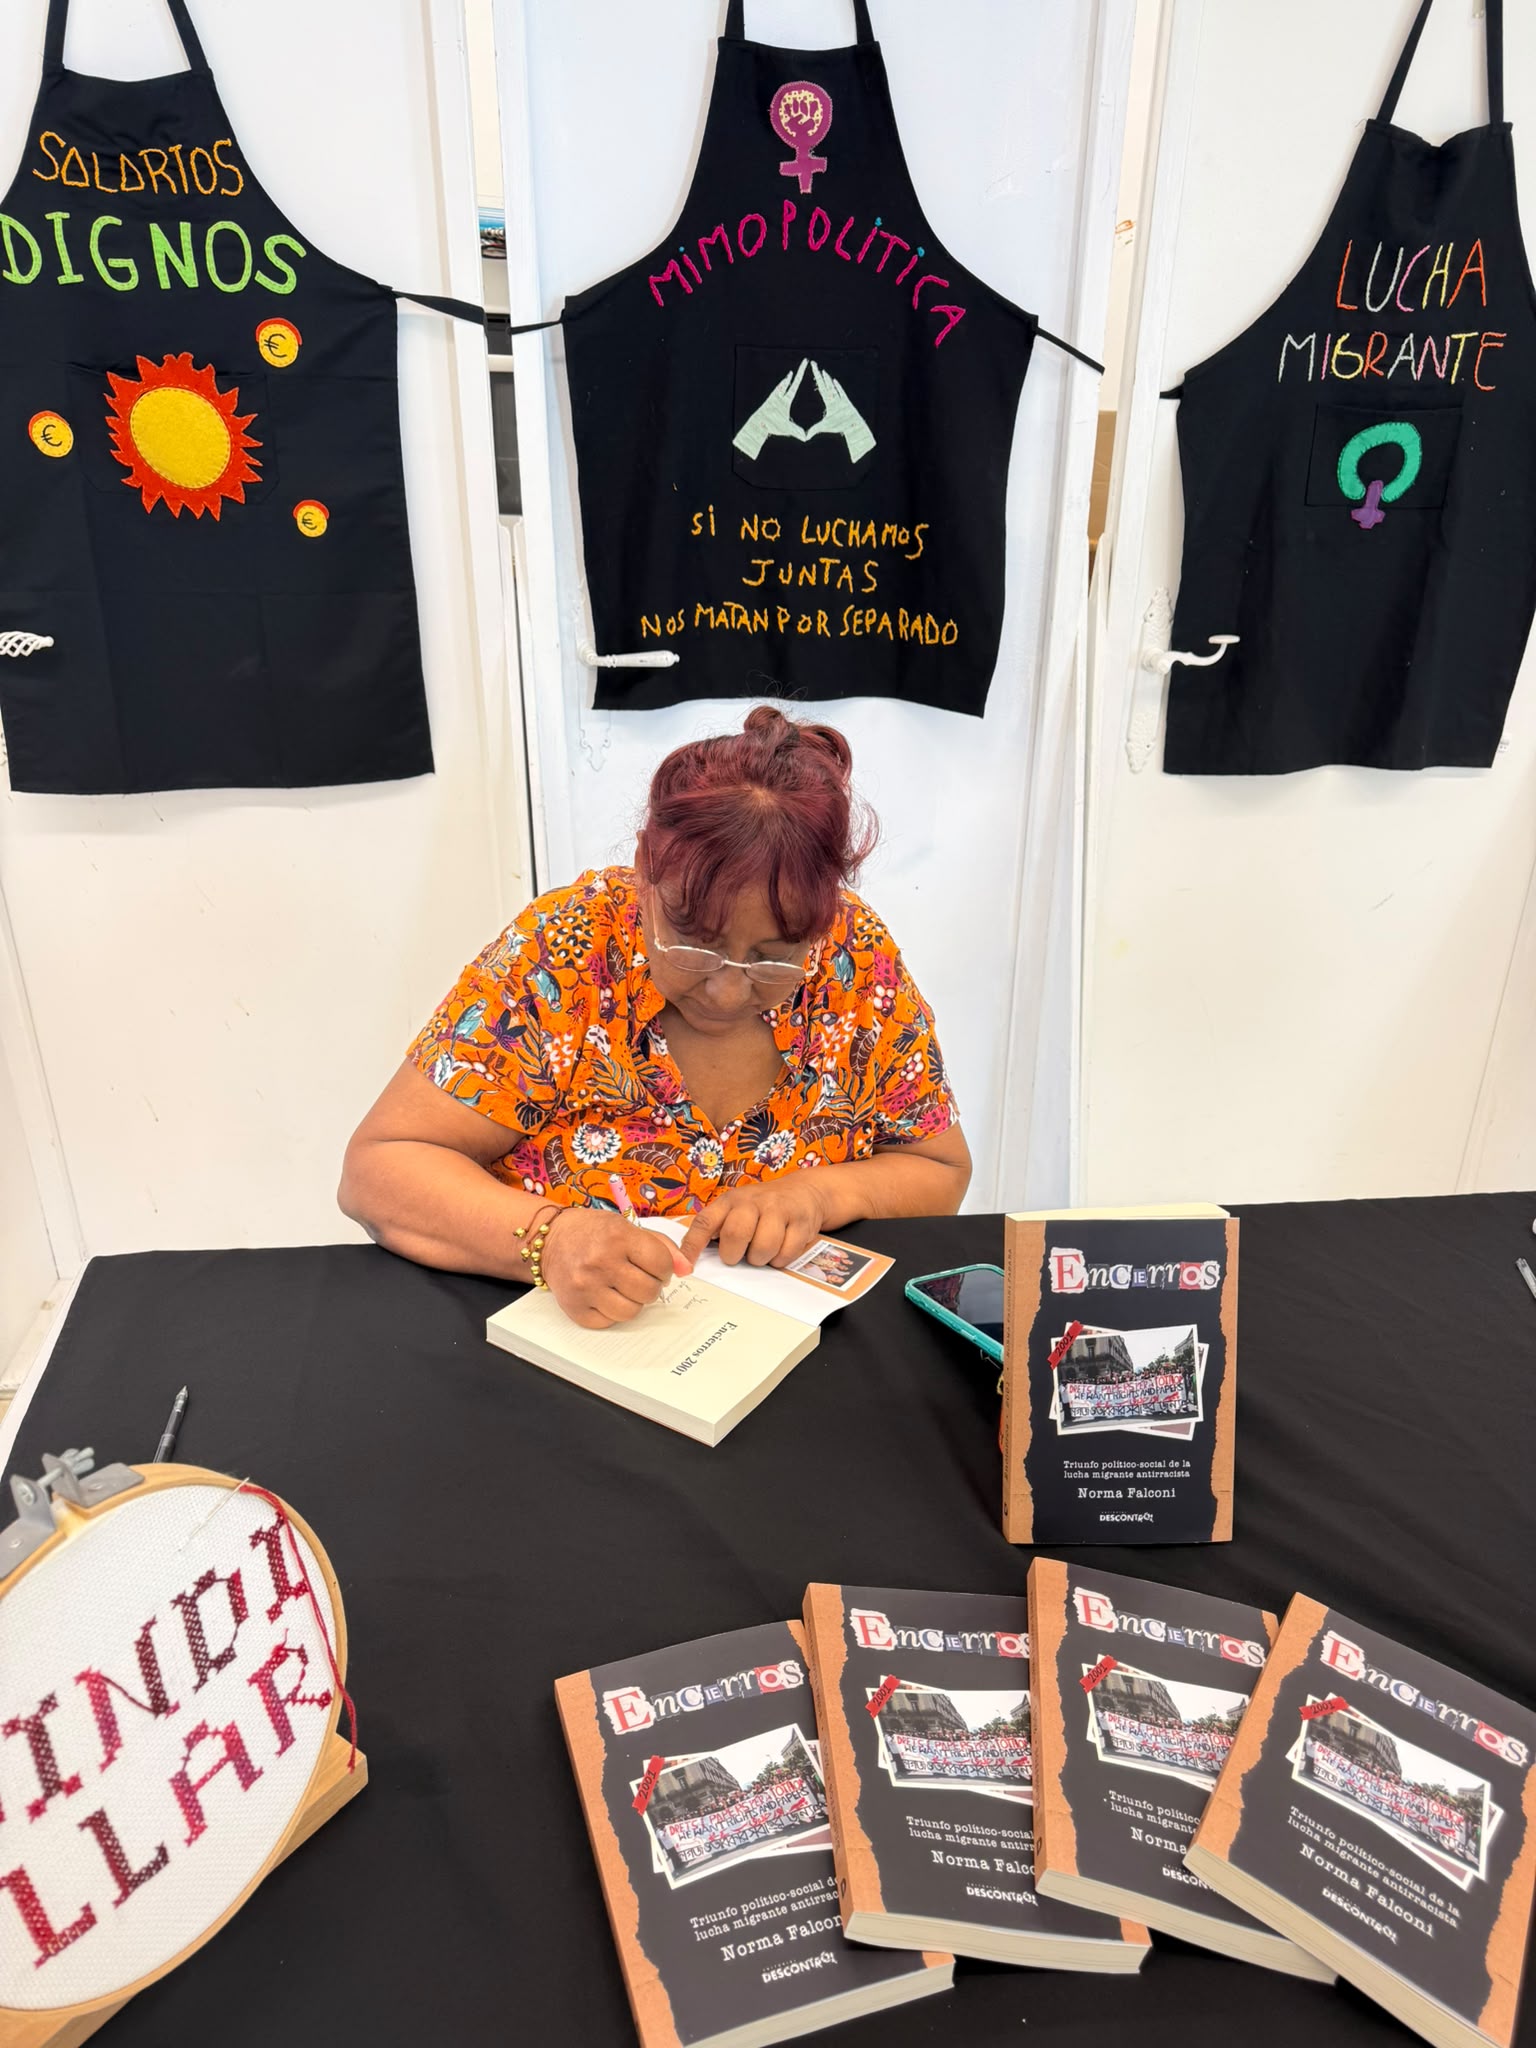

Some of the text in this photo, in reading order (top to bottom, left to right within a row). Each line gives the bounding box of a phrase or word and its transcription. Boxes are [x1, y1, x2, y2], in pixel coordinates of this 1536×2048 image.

[0, 211, 307, 295] DIGNOS
[1336, 238, 1487, 312] LUCHA
[1278, 330, 1507, 391] MIGRANTE
[740, 513, 782, 542] NO
[801, 515, 930, 560] LUCHAMOS
[742, 557, 879, 593] JUNTAS
[640, 601, 959, 645] NOS MATAN POR SEPARADO
[670, 1321, 738, 1376] Encierros 2001
[1055, 1332, 1074, 1357] 2001
[1063, 1459, 1191, 1470] Triunfo político-social de la
[1063, 1470, 1190, 1480] lucha migrante antirracista
[1077, 1487, 1176, 1499] Norma Falconi
[0, 1508, 310, 1825] INDI
[1088, 1664, 1108, 1683] 2001
[873, 1685, 891, 1707] 2001
[1310, 1701, 1335, 1715] 2001
[638, 1769, 657, 1799] 2001
[1108, 1789, 1201, 1825] Triunfo político
[1110, 1801, 1144, 1819] lucha
[906, 1816, 1034, 1840] Triunfo político-social
[909, 1827, 942, 1840] lucha
[945, 1833, 998, 1848] migrante
[1130, 1826, 1187, 1855] Norma
[930, 1850, 1036, 1875] Norma Falco
[1287, 1815, 1321, 1842] lucha
[1323, 1839, 1380, 1879] migrante
[1382, 1876, 1459, 1928] antirracista
[1290, 1805, 1461, 1918] Triunfo político-social de la
[689, 1905, 738, 1929] Triunfo
[740, 1879, 825, 1915] político-social
[1300, 1843, 1361, 1890] Norma
[1365, 1884, 1434, 1938] Falconi
[694, 1890, 839, 1942] lucha migrante antirrac
[720, 1914, 843, 1962] Norma Falcon
